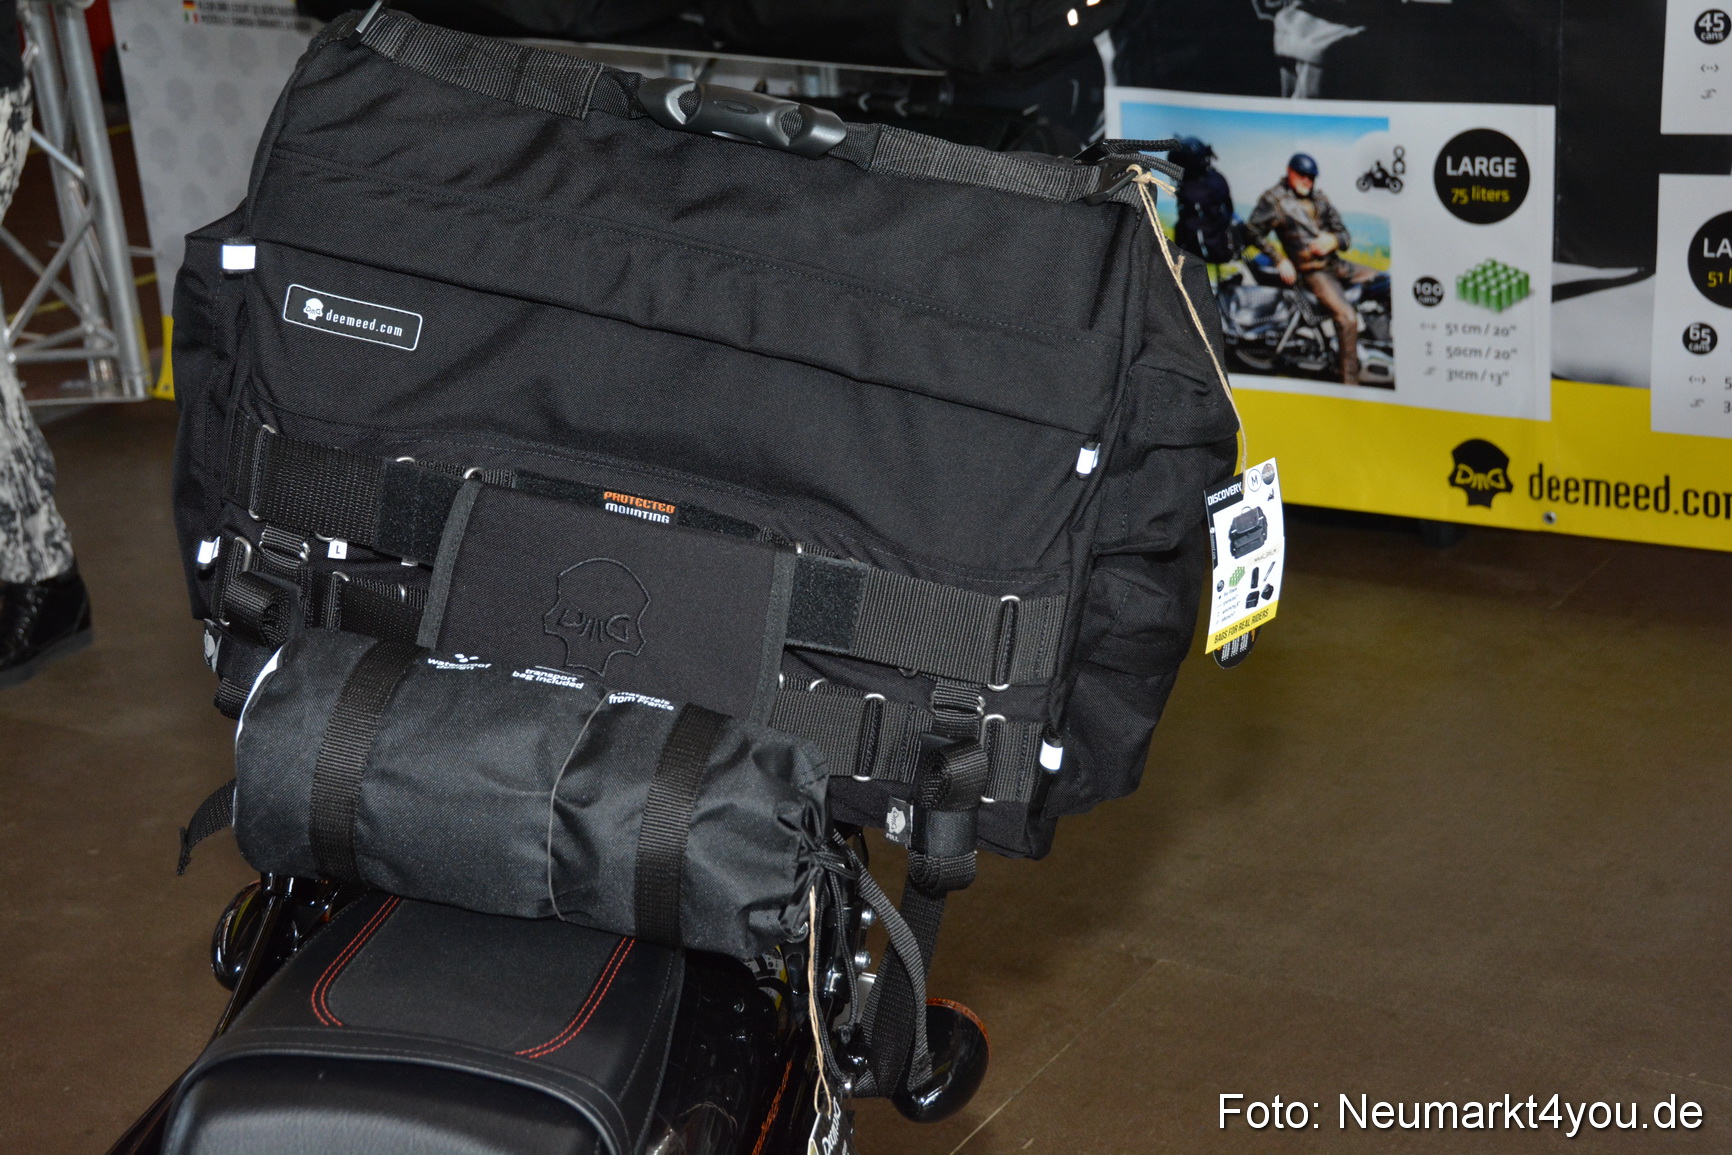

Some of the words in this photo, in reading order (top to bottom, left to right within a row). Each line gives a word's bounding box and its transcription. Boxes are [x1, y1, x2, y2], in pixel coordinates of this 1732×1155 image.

[1698, 12, 1725, 32] 45
[1700, 32, 1724, 41] cans
[1446, 155, 1517, 178] LARGE
[1451, 187, 1469, 205] 75
[1471, 185, 1510, 203] liters
[1415, 281, 1443, 297] 100
[1708, 271, 1723, 288] 51
[326, 309, 403, 337] deemeed.com
[1689, 324, 1711, 345] 65
[1246, 475, 1258, 486] M
[603, 491, 676, 514] PROTECTED
[1207, 482, 1242, 506] DISCOVERY
[605, 502, 670, 524] MOUNTING
[1214, 630, 1228, 644] BAGS
[1251, 608, 1269, 625] RIDERS
[512, 670, 535, 681] bag
[535, 676, 585, 690] included
[525, 668, 578, 682] transport
[609, 693, 636, 705] from
